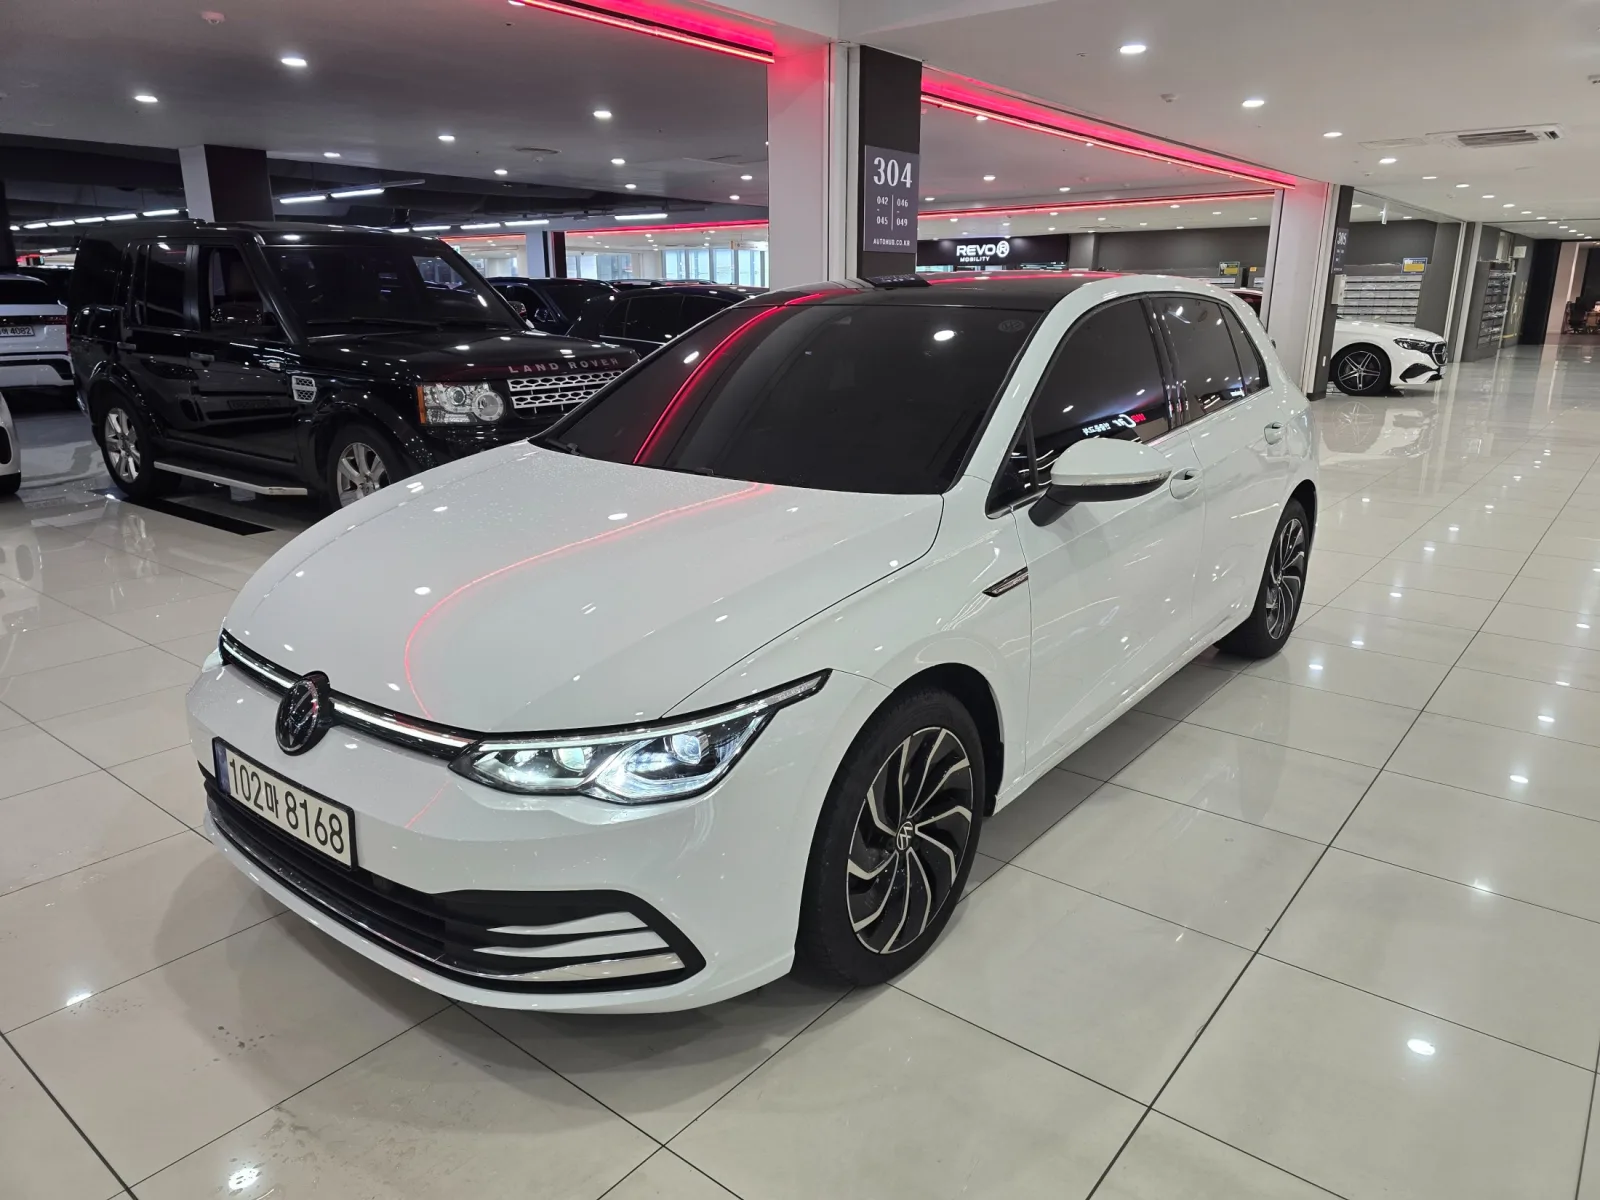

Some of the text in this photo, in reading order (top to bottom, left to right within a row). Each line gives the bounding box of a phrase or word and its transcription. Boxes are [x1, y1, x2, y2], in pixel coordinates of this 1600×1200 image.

[873, 156, 913, 188] 304
[877, 196, 888, 205] 042
[897, 199, 908, 207] 046
[877, 216, 888, 225] 045
[897, 218, 908, 226] 049
[956, 244, 996, 256] REVO
[11, 327, 31, 335] 4082
[508, 357, 619, 374] LAND ROVER
[229, 758, 345, 855] 102마 8168
